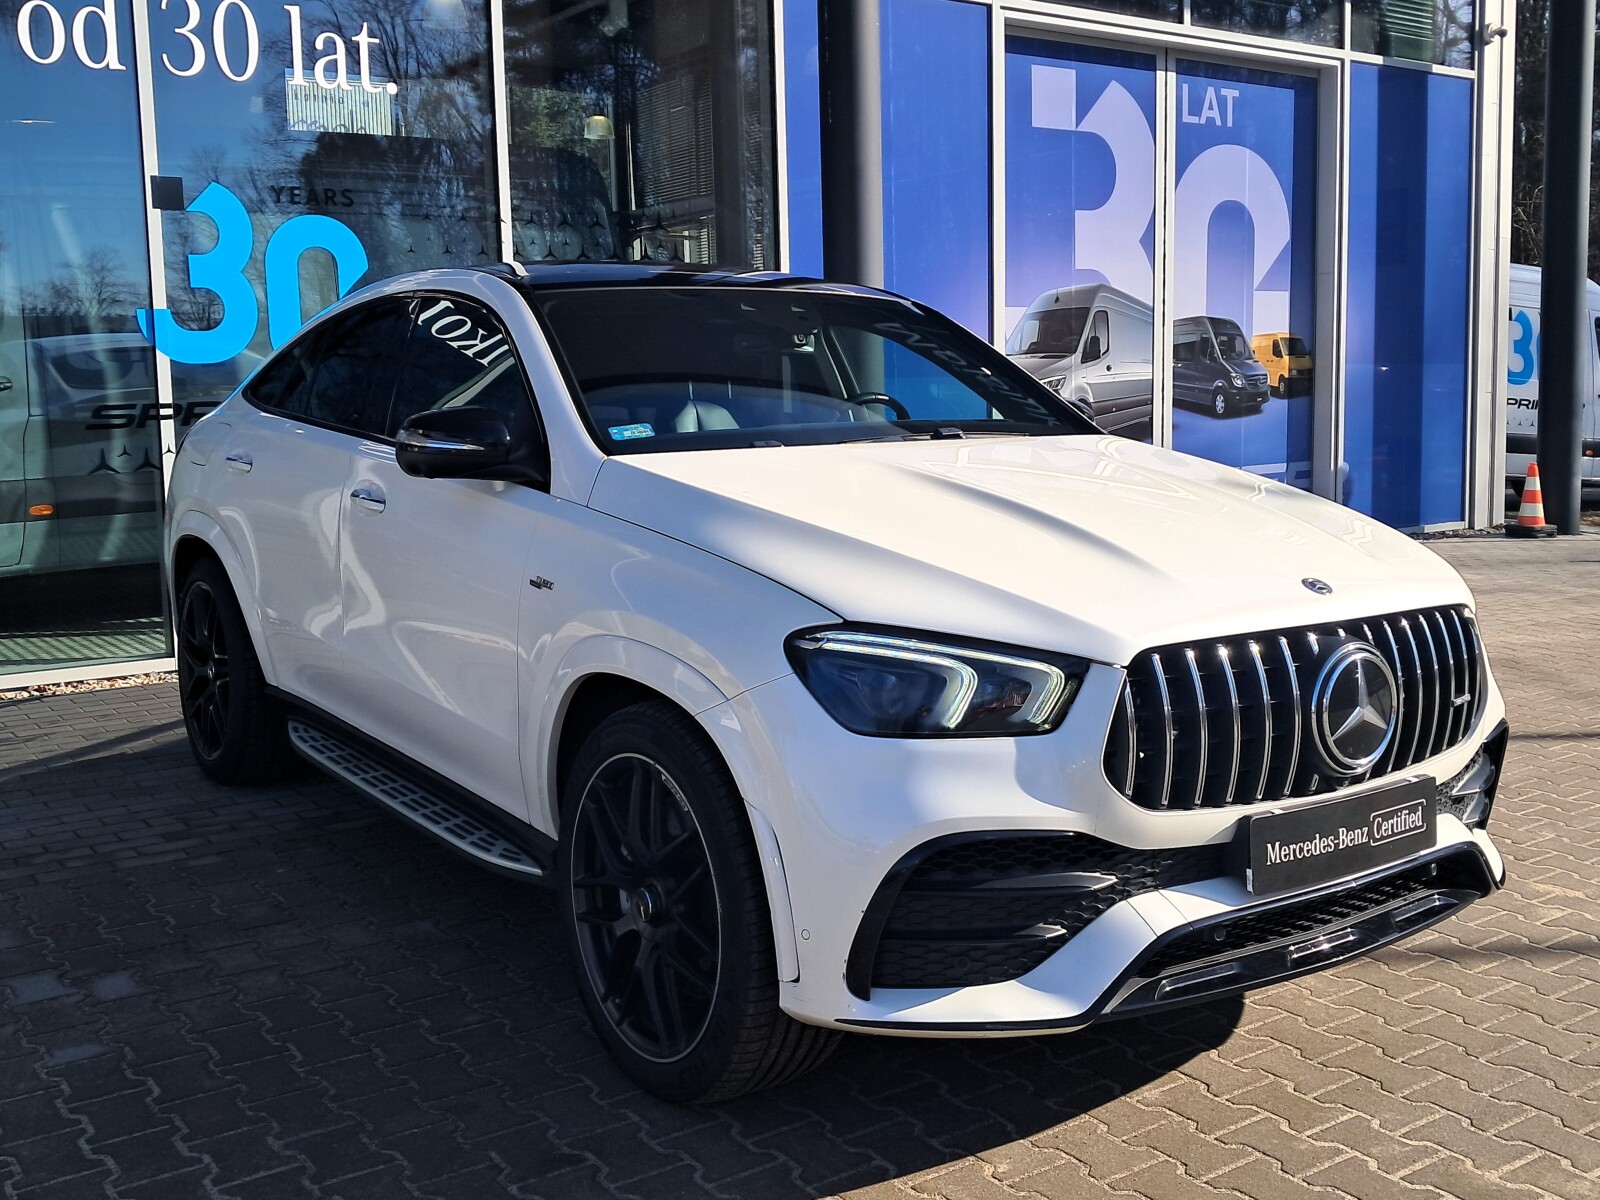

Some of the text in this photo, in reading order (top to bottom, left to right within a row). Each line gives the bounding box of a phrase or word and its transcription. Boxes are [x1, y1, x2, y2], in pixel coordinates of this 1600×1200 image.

[17, 0, 398, 95] od 30 lat.
[1182, 83, 1240, 127] LAT
[269, 185, 354, 207] YEARS
[1507, 309, 1540, 386] 3
[1266, 806, 1423, 866] Mercedes-Benz Certified
